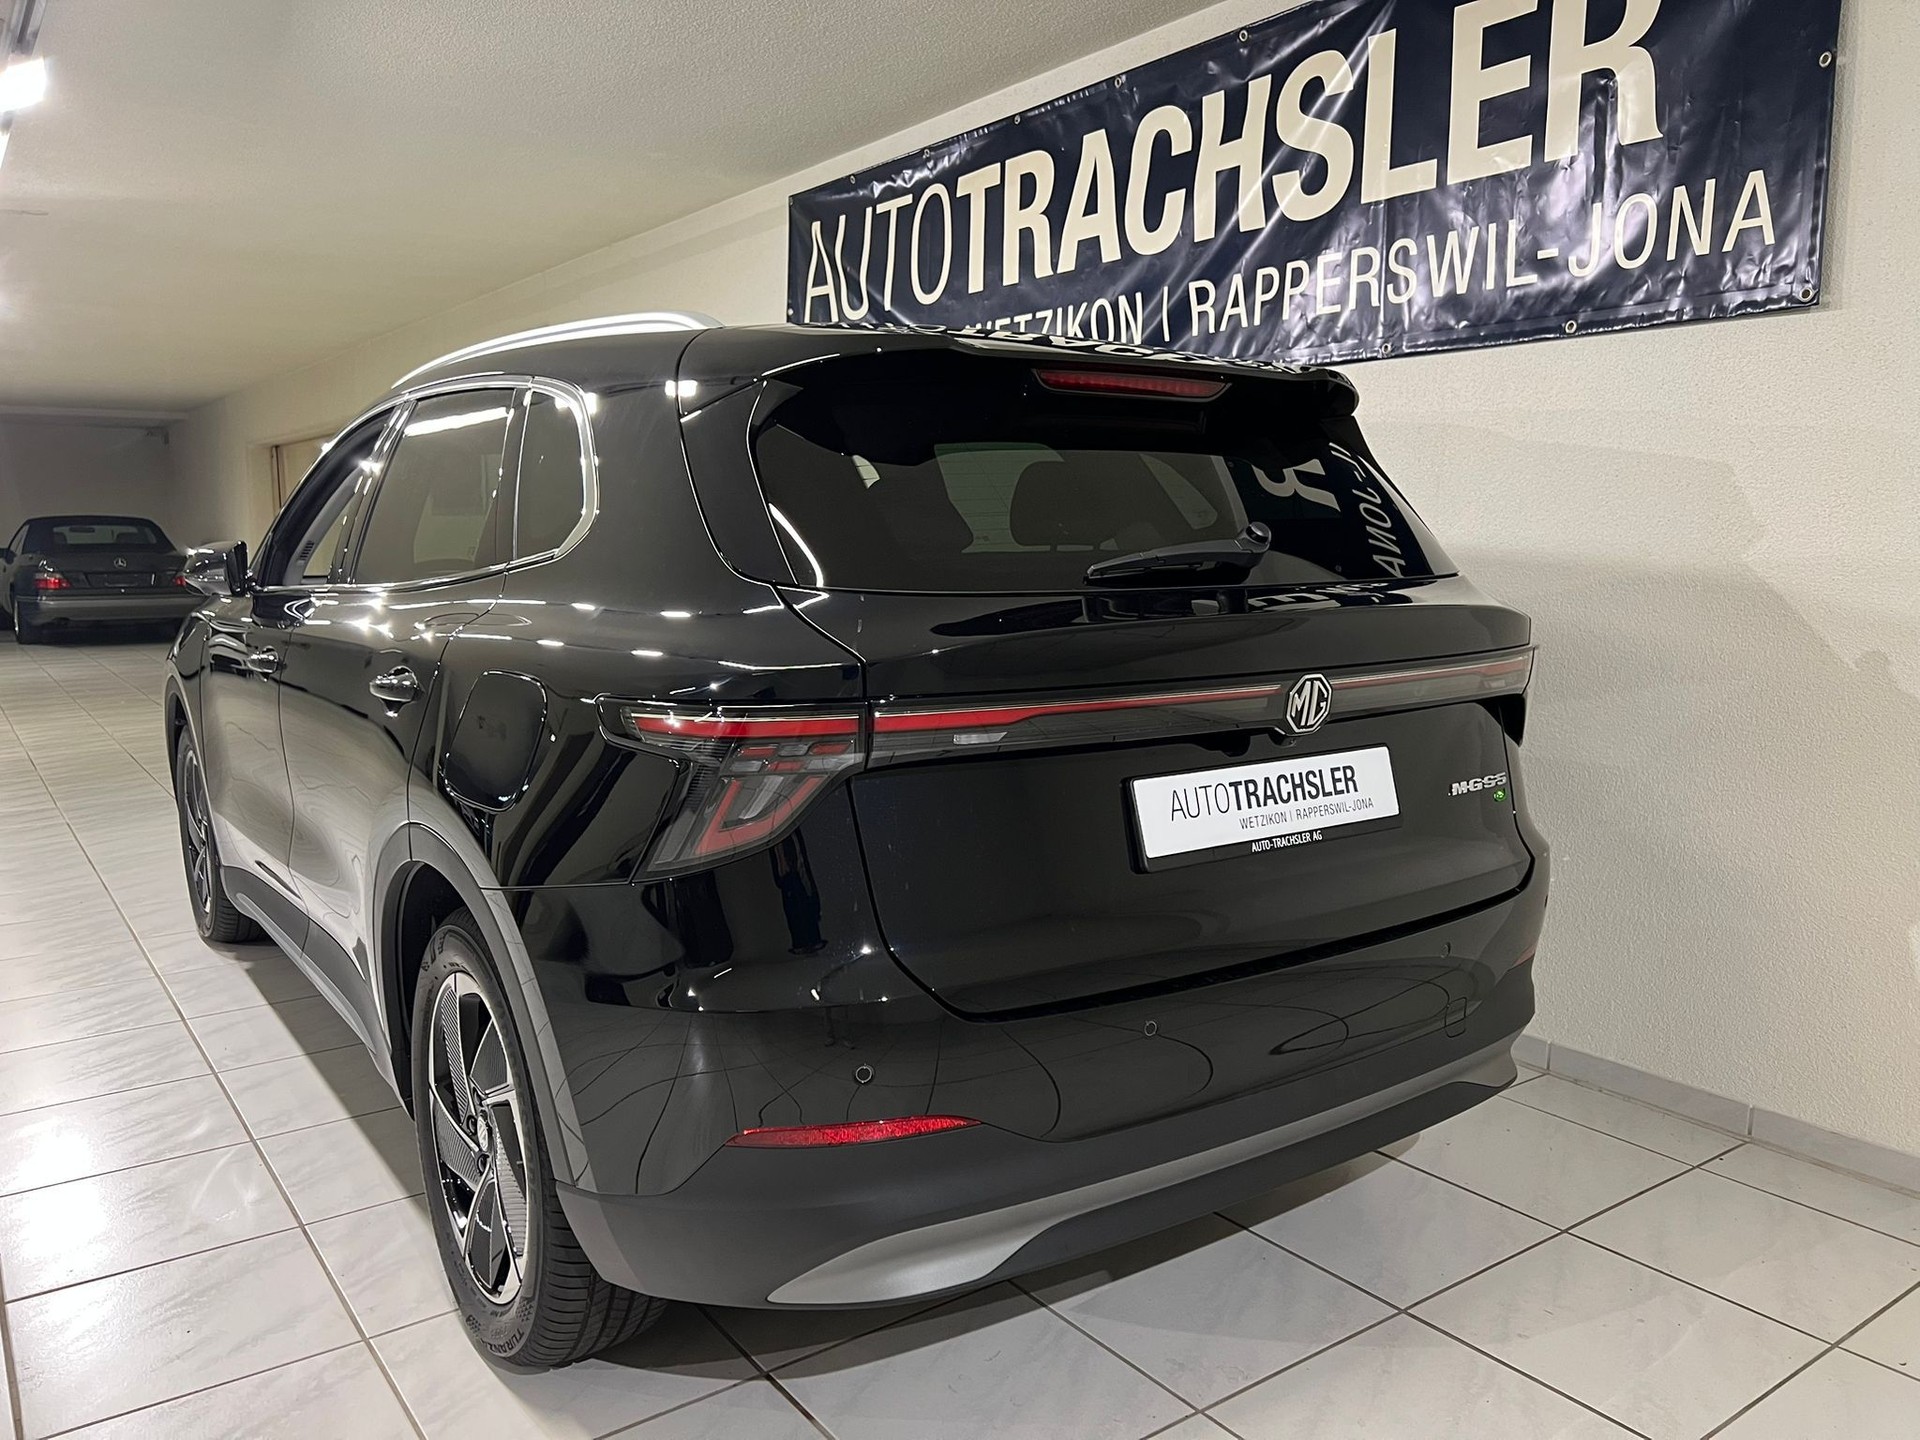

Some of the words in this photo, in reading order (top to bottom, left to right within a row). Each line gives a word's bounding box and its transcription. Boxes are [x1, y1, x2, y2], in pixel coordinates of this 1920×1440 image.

[804, 0, 1664, 324] AUTOTRACHSLER
[965, 291, 1143, 345] TZIKON
[1190, 169, 1777, 337] RAPPERSWIL-JONA
[1290, 680, 1328, 726] MG
[1171, 764, 1359, 822] AUTOTRACHSLER
[1239, 811, 1288, 830] WETZIKON
[1295, 797, 1375, 821] RAPPERSWIL-JONA
[1251, 831, 1312, 853] AUTO-TRACHSLER
[1312, 830, 1323, 841] AG
